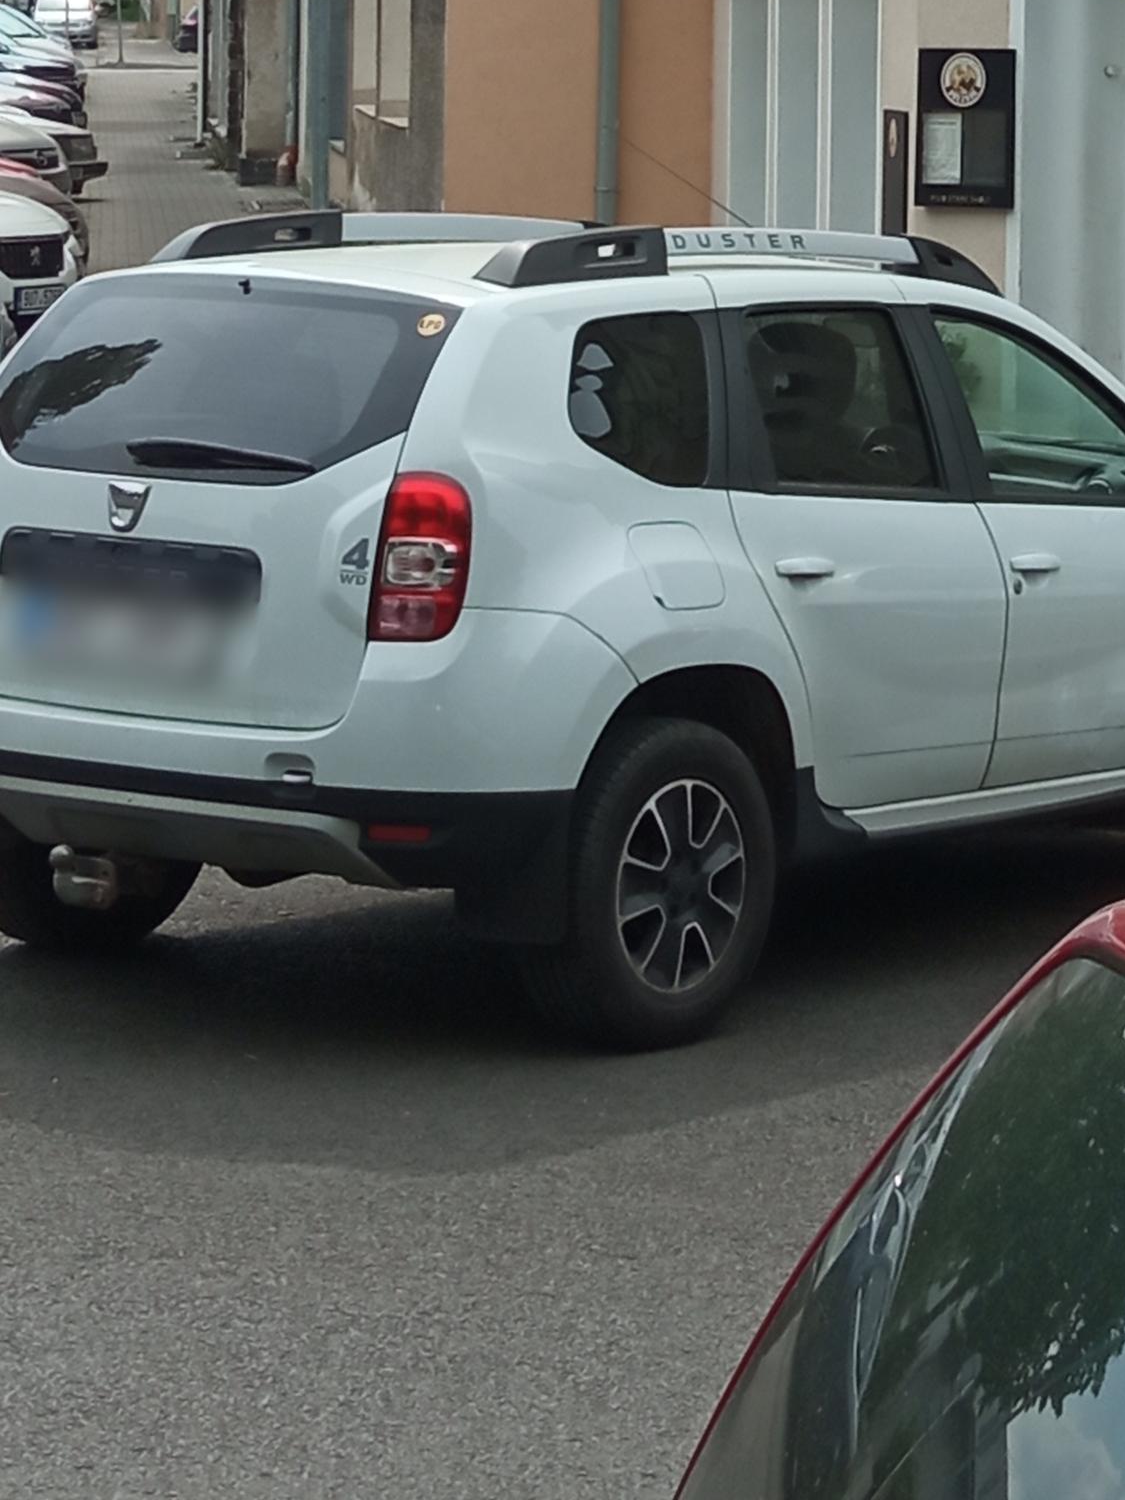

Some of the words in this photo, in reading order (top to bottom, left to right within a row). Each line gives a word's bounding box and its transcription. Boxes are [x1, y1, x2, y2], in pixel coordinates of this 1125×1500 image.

[672, 233, 806, 250] DUSTER
[420, 316, 443, 332] LPG
[341, 537, 370, 571] 4
[339, 572, 367, 587] WD
